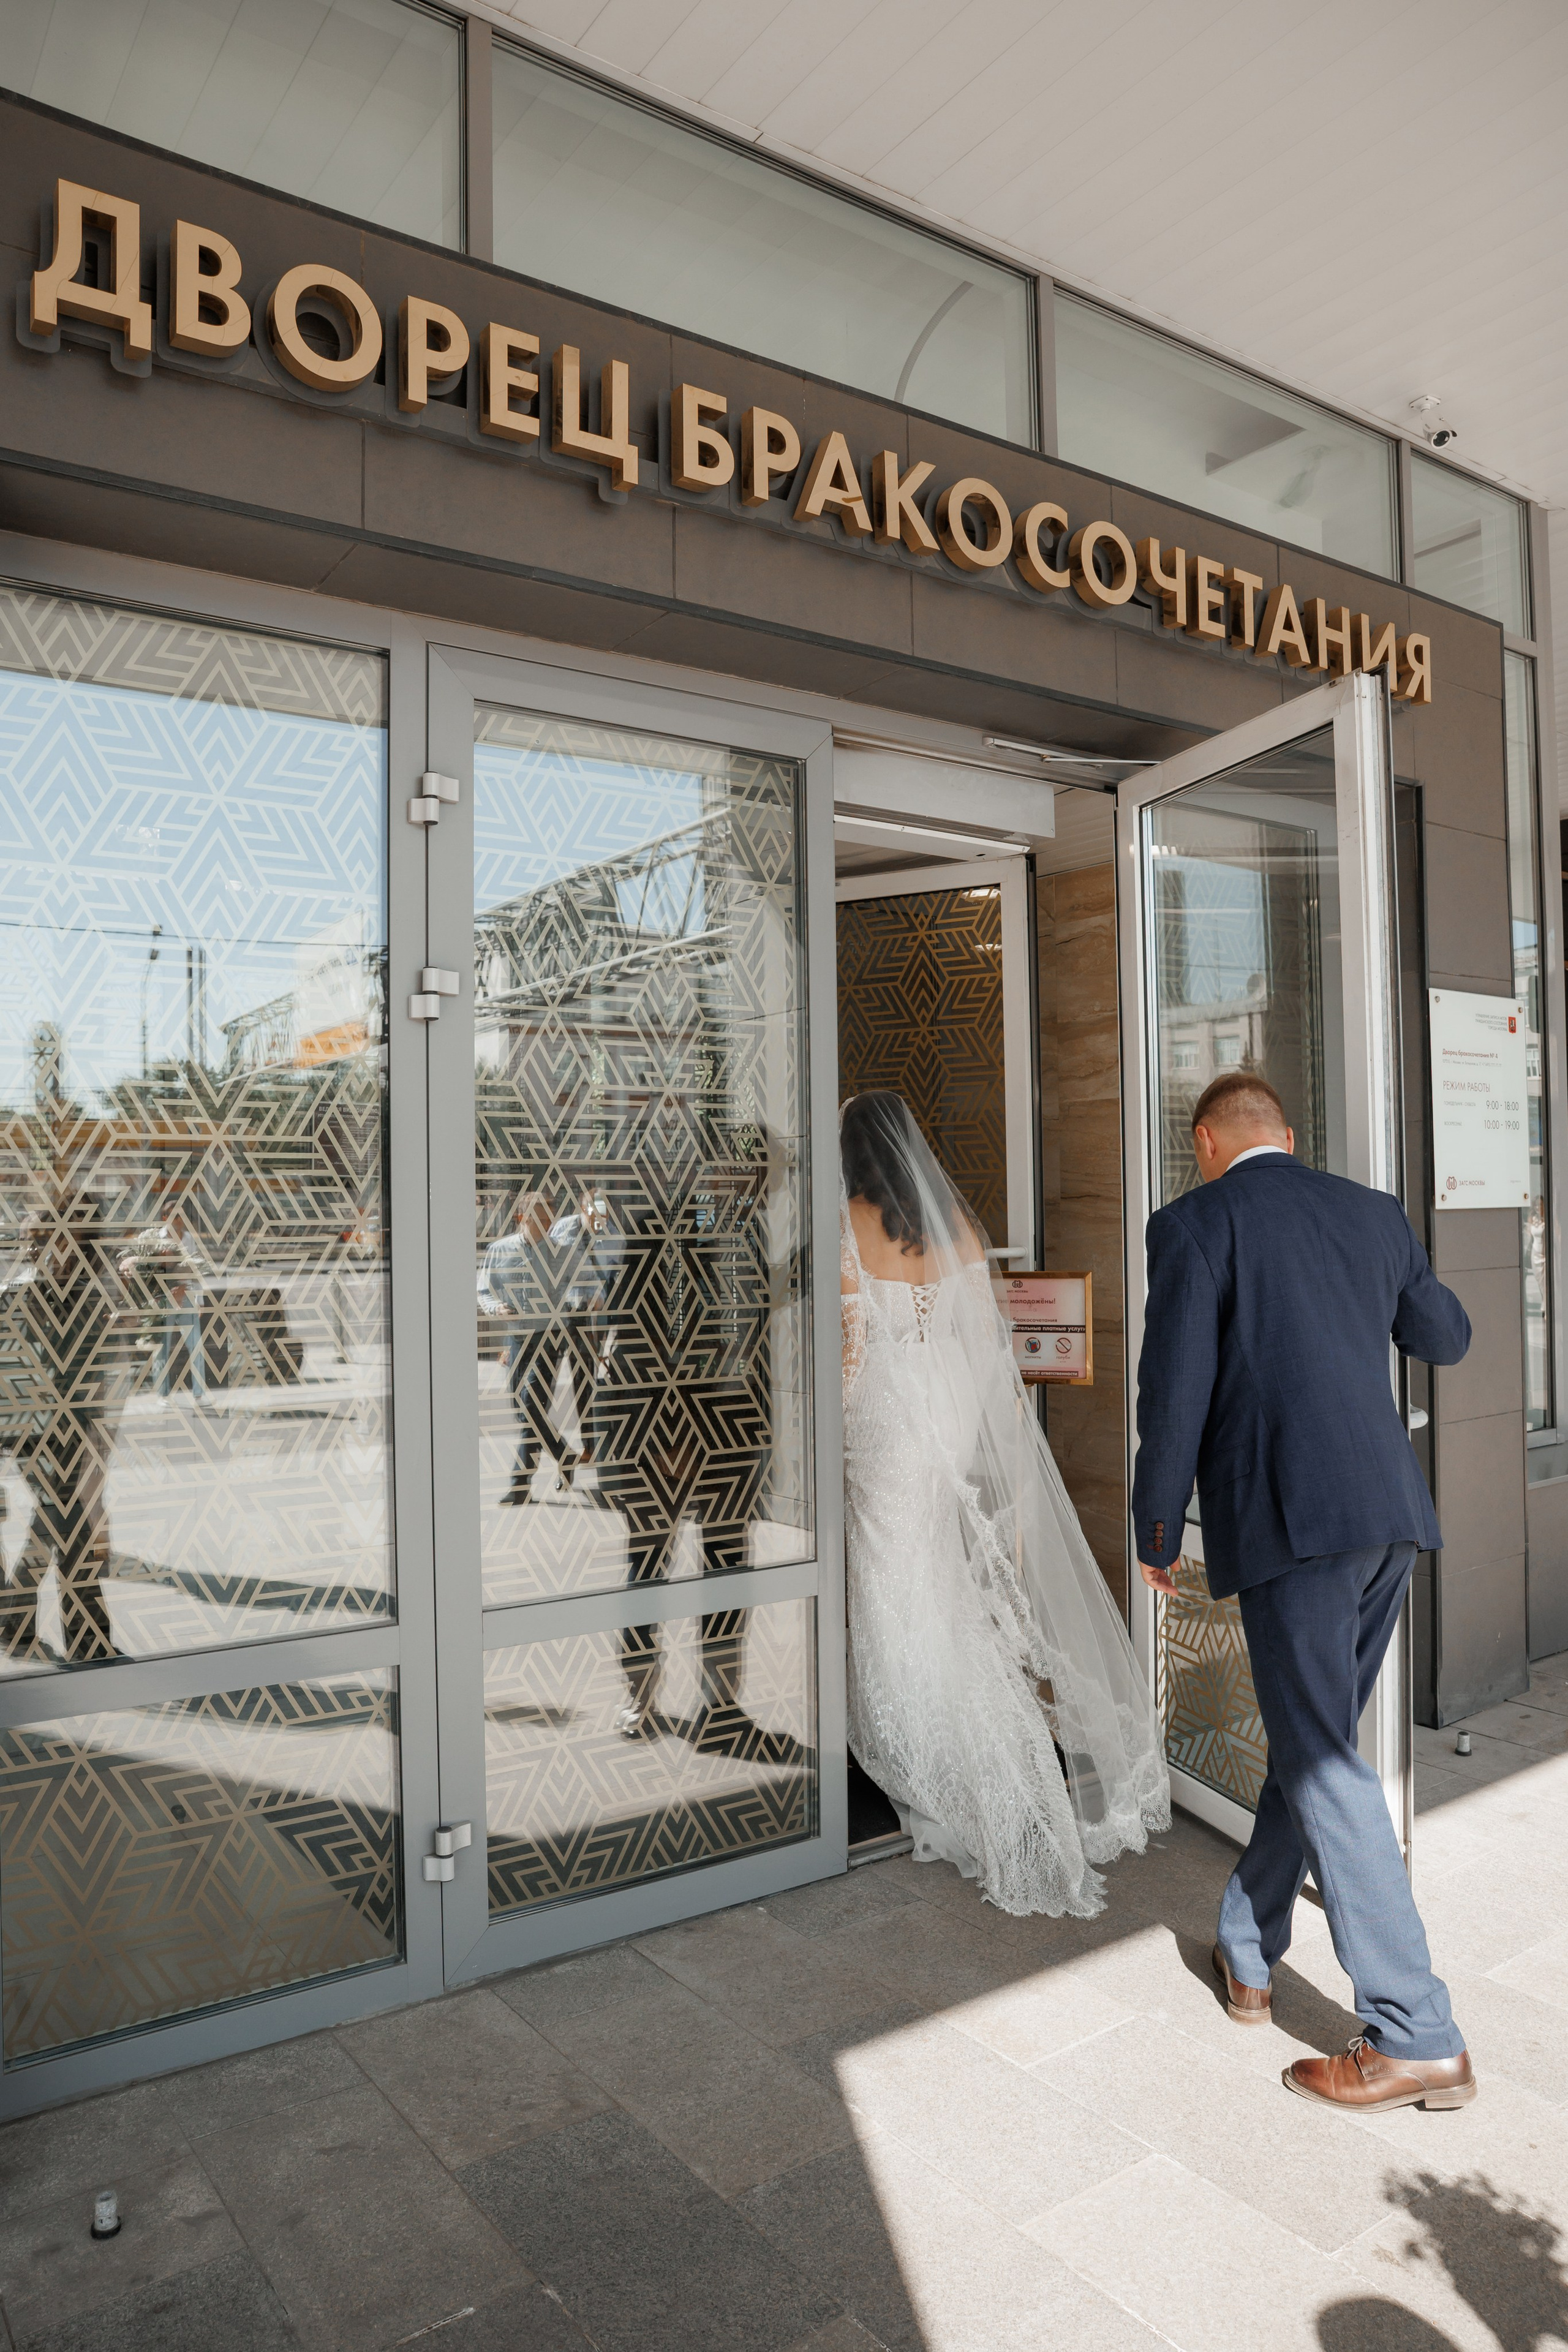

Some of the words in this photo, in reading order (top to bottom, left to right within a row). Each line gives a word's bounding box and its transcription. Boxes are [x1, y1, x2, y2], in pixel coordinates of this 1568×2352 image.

[30, 178, 638, 492] ДВОРЕЦ
[670, 383, 1432, 706] БРАКОСОЧЕТАНИЯ
[1442, 1048, 1458, 1057] Дворец
[1458, 1050, 1489, 1058] бракосочетания
[1443, 1080, 1466, 1091] РЕЖИМ
[1468, 1082, 1491, 1093] РАБОТЫ
[1486, 1100, 1499, 1110] 9:00
[1504, 1101, 1519, 1111] 18:00
[1484, 1120, 1500, 1129] 10:00
[1505, 1120, 1520, 1130] 19:00
